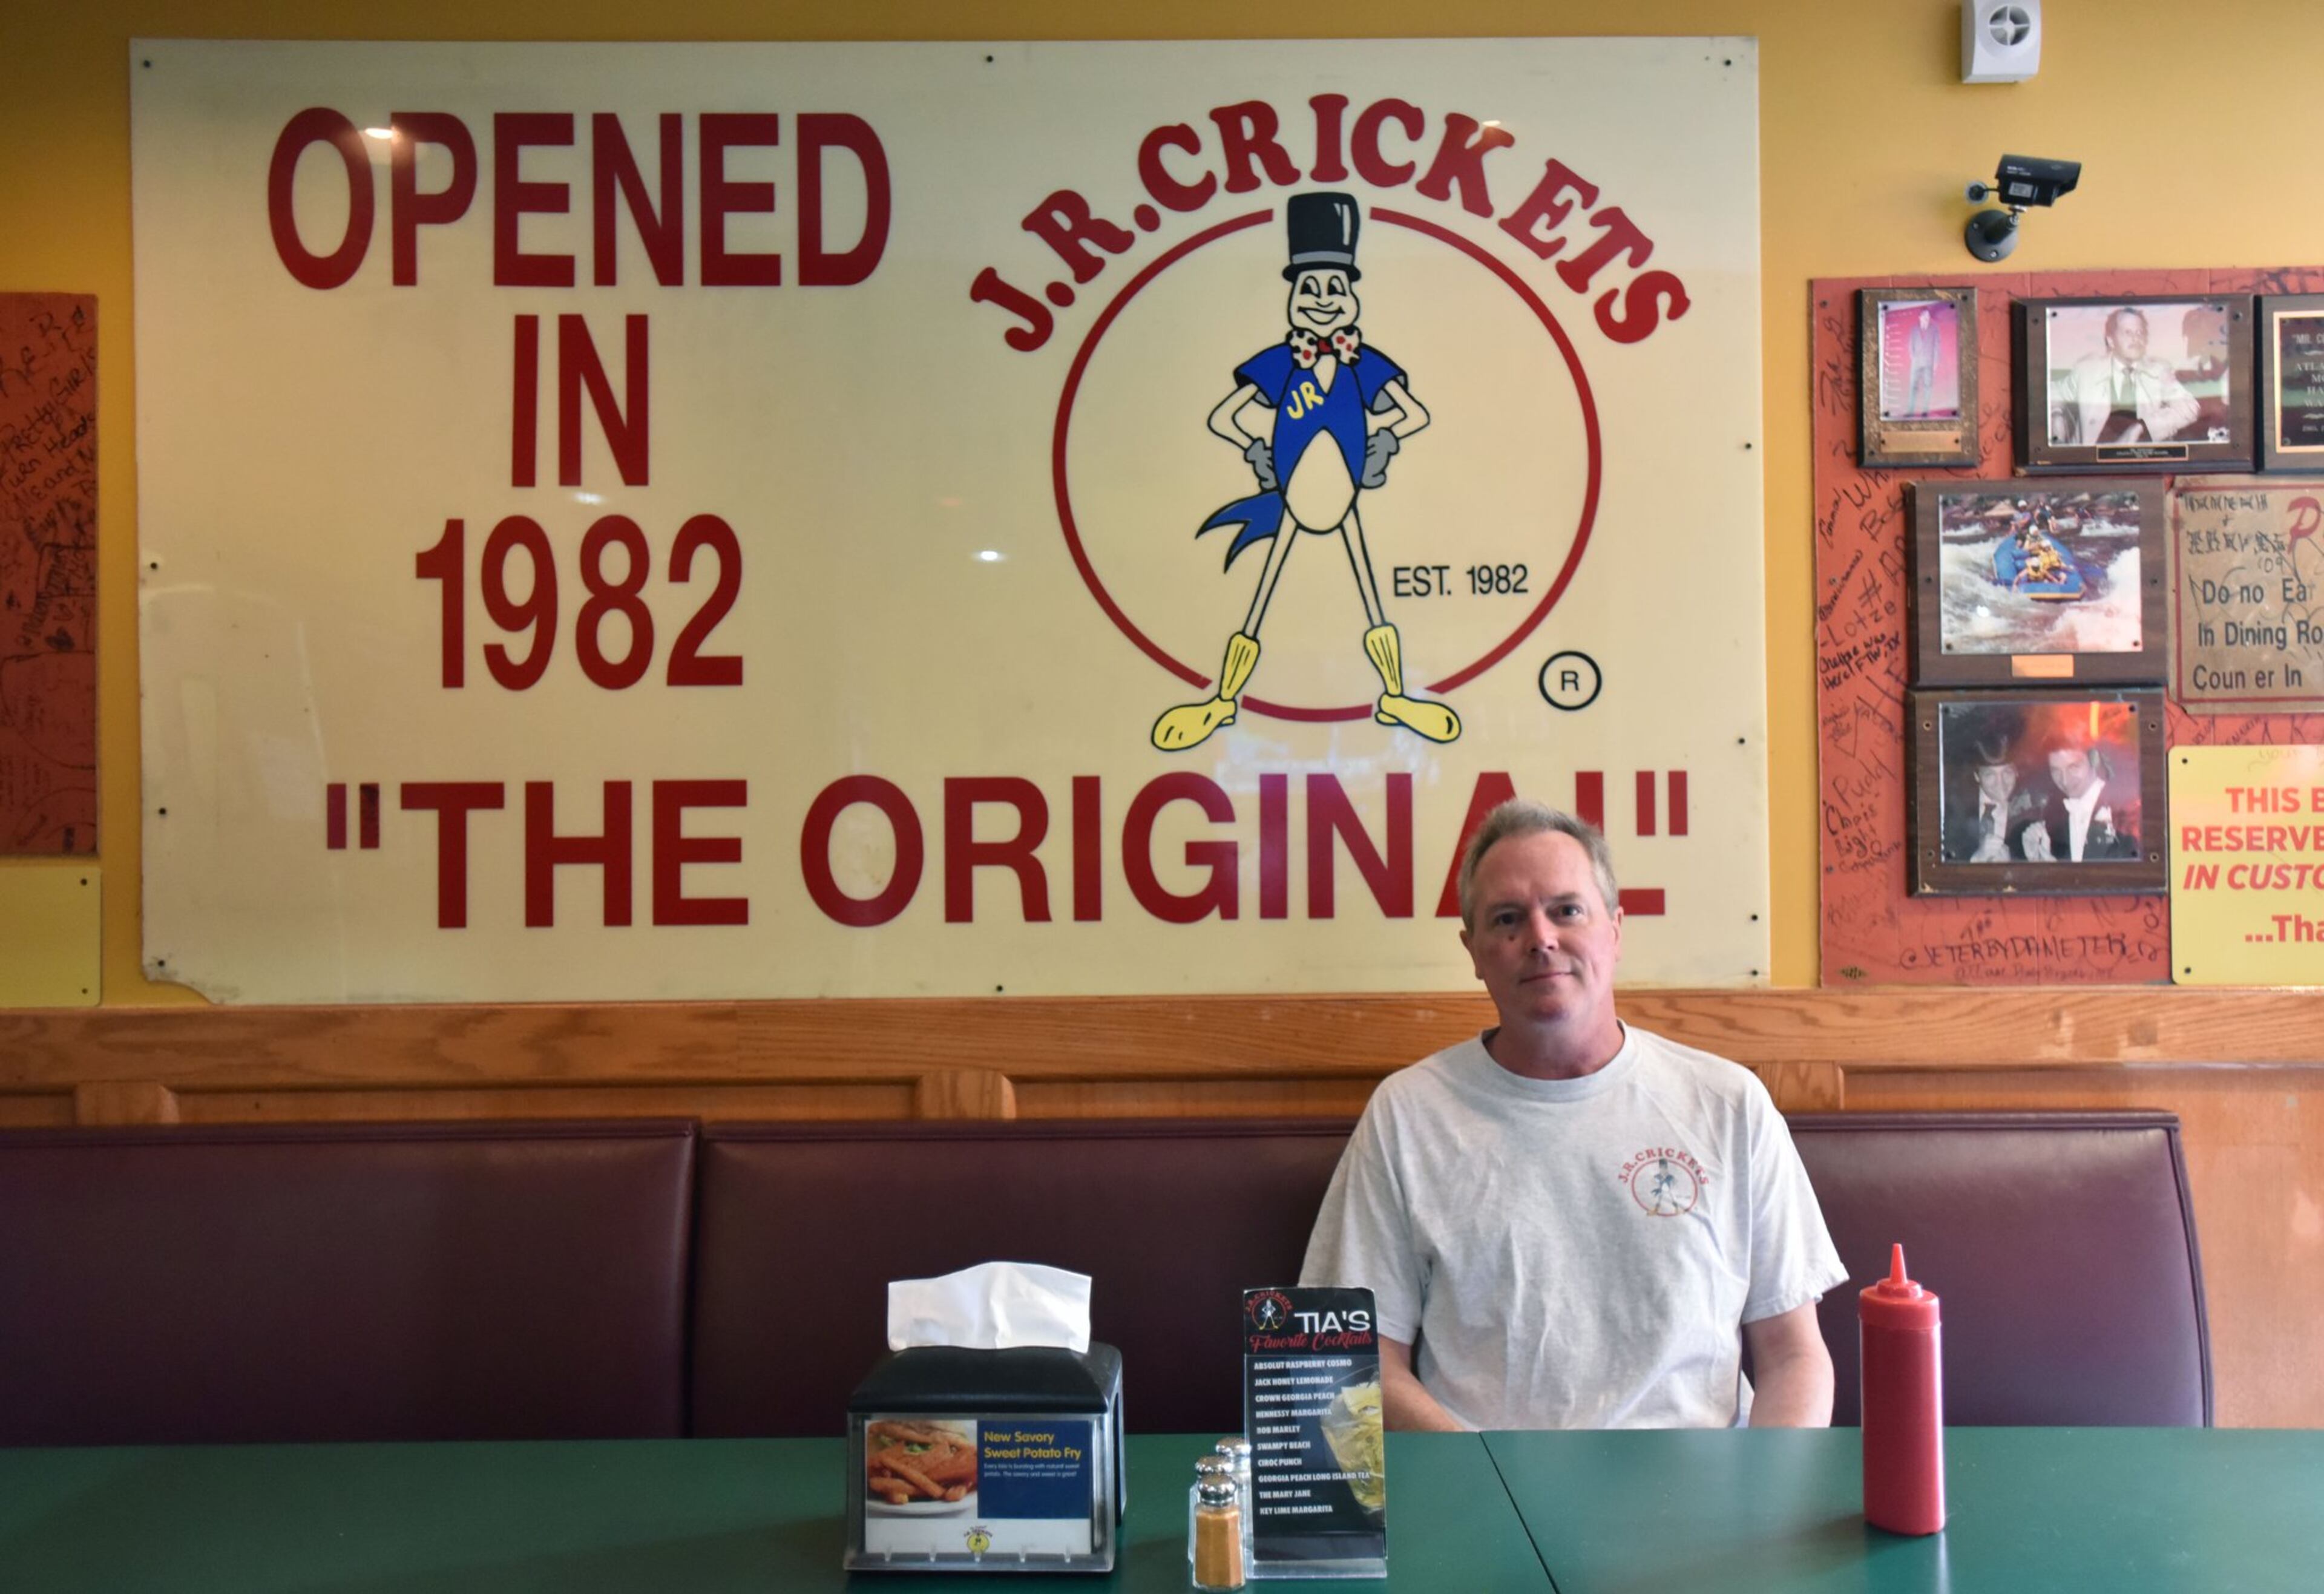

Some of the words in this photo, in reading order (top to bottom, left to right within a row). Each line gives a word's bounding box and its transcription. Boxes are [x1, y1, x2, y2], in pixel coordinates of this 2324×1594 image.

[268, 107, 891, 290] OPENED
[511, 313, 649, 487] IN
[1286, 381, 1324, 420] JR
[1393, 565, 1452, 597] EST.
[1466, 563, 1529, 595] 1982
[2202, 579, 2230, 605] Do
[416, 514, 743, 691] 1982
[2198, 622, 2214, 647] In
[2224, 620, 2288, 652] Dining
[2285, 662, 2302, 687] In
[2225, 787, 2300, 813] THIS
[2183, 864, 2221, 891] IN
[1293, 1310, 1371, 1334] TIA'S
[1249, 1333, 1308, 1353] Favorite
[1312, 1332, 1372, 1352] Cocktails
[1285, 1360, 1325, 1369] RASPBERRY
[1296, 1376, 1333, 1385] LEMONADE
[1282, 1393, 1312, 1402] GEORGIA
[984, 1431, 1011, 1443] New
[1014, 1431, 1055, 1445] Savory
[1272, 1425, 1300, 1434] MARLEY
[984, 1447, 1021, 1459] Sweet
[1023, 1447, 1062, 1459] Potato
[1063, 1446, 1082, 1460] Fry
[1257, 1442, 1288, 1451] SWAMPY
[1289, 1441, 1311, 1449] BEACH
[1290, 1473, 1311, 1481] PEACH
[1332, 1472, 1357, 1480] ISLAND
[1292, 1505, 1333, 1514] MARGARITA
